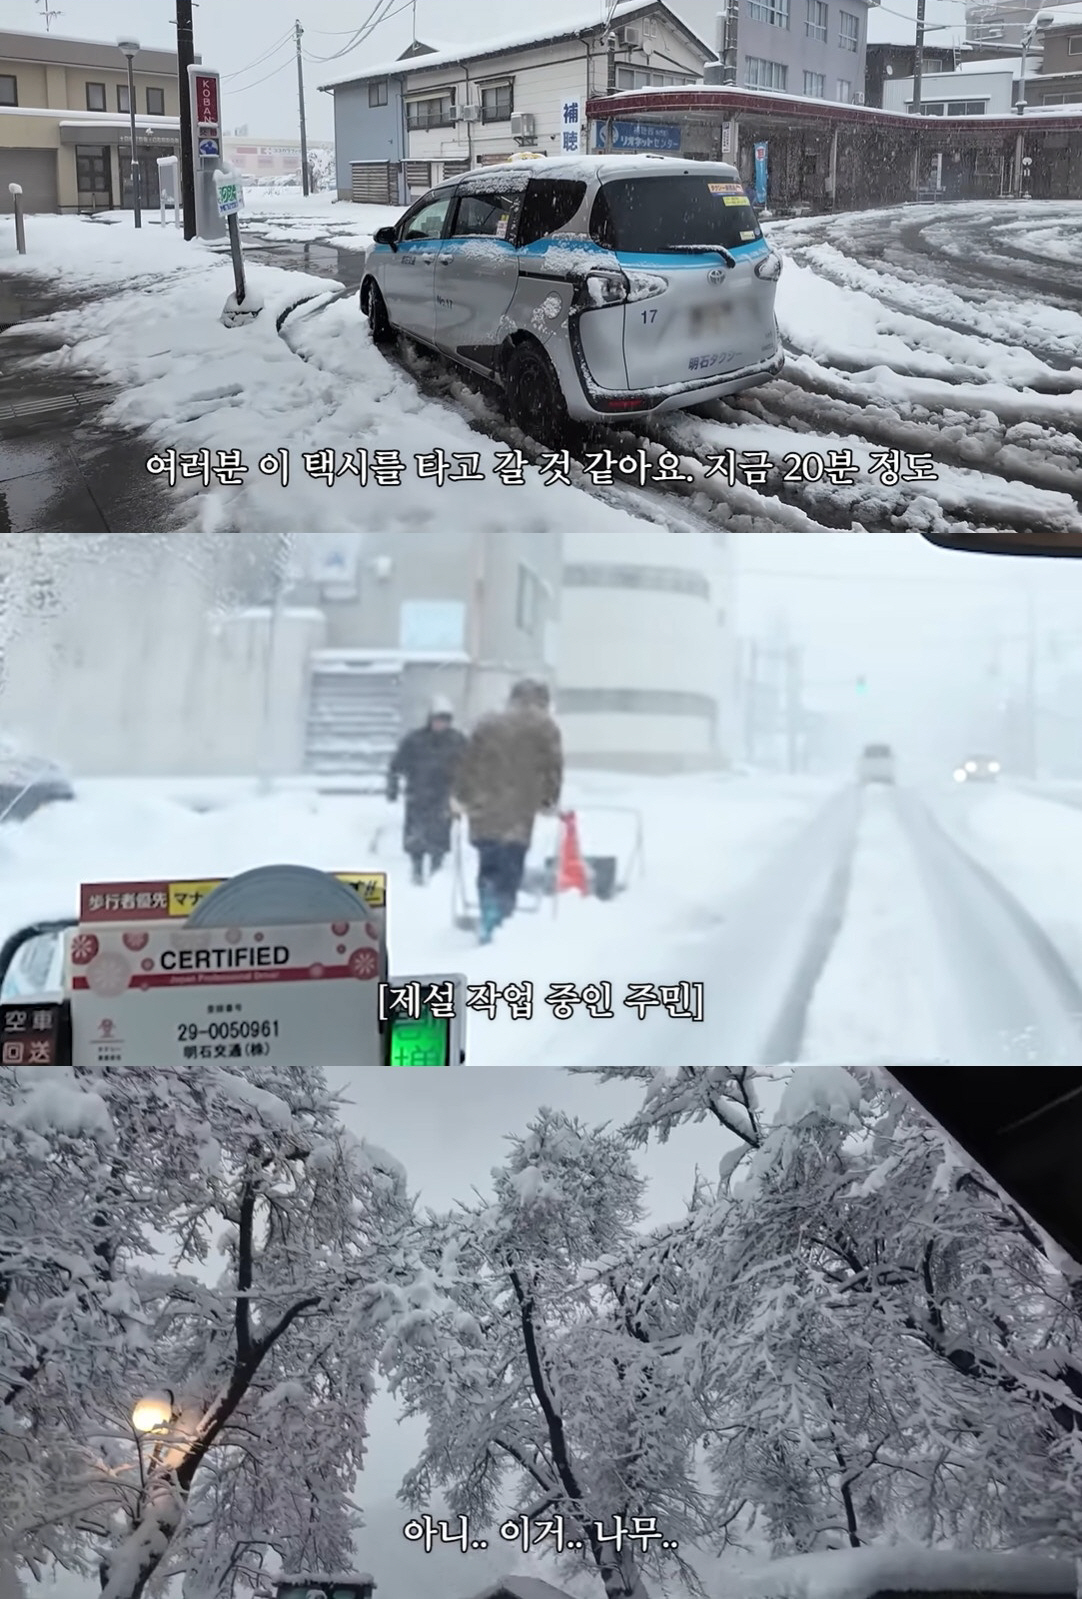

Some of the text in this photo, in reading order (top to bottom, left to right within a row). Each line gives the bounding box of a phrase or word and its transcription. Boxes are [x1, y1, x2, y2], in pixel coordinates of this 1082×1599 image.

[202, 80, 212, 124] KOBAN
[563, 103, 580, 152] 補聴
[620, 136, 679, 149] リオネットセンター
[641, 309, 658, 324] 17
[688, 352, 743, 371] 明石タクシー
[88, 889, 167, 912] 歩行者優先
[160, 946, 290, 970] CERTIFIED
[4, 1009, 53, 1032] 空車
[177, 1019, 279, 1042] 29-0050961
[2, 1040, 51, 1064] 回送
[183, 1041, 271, 1059] 明石交通(株)
